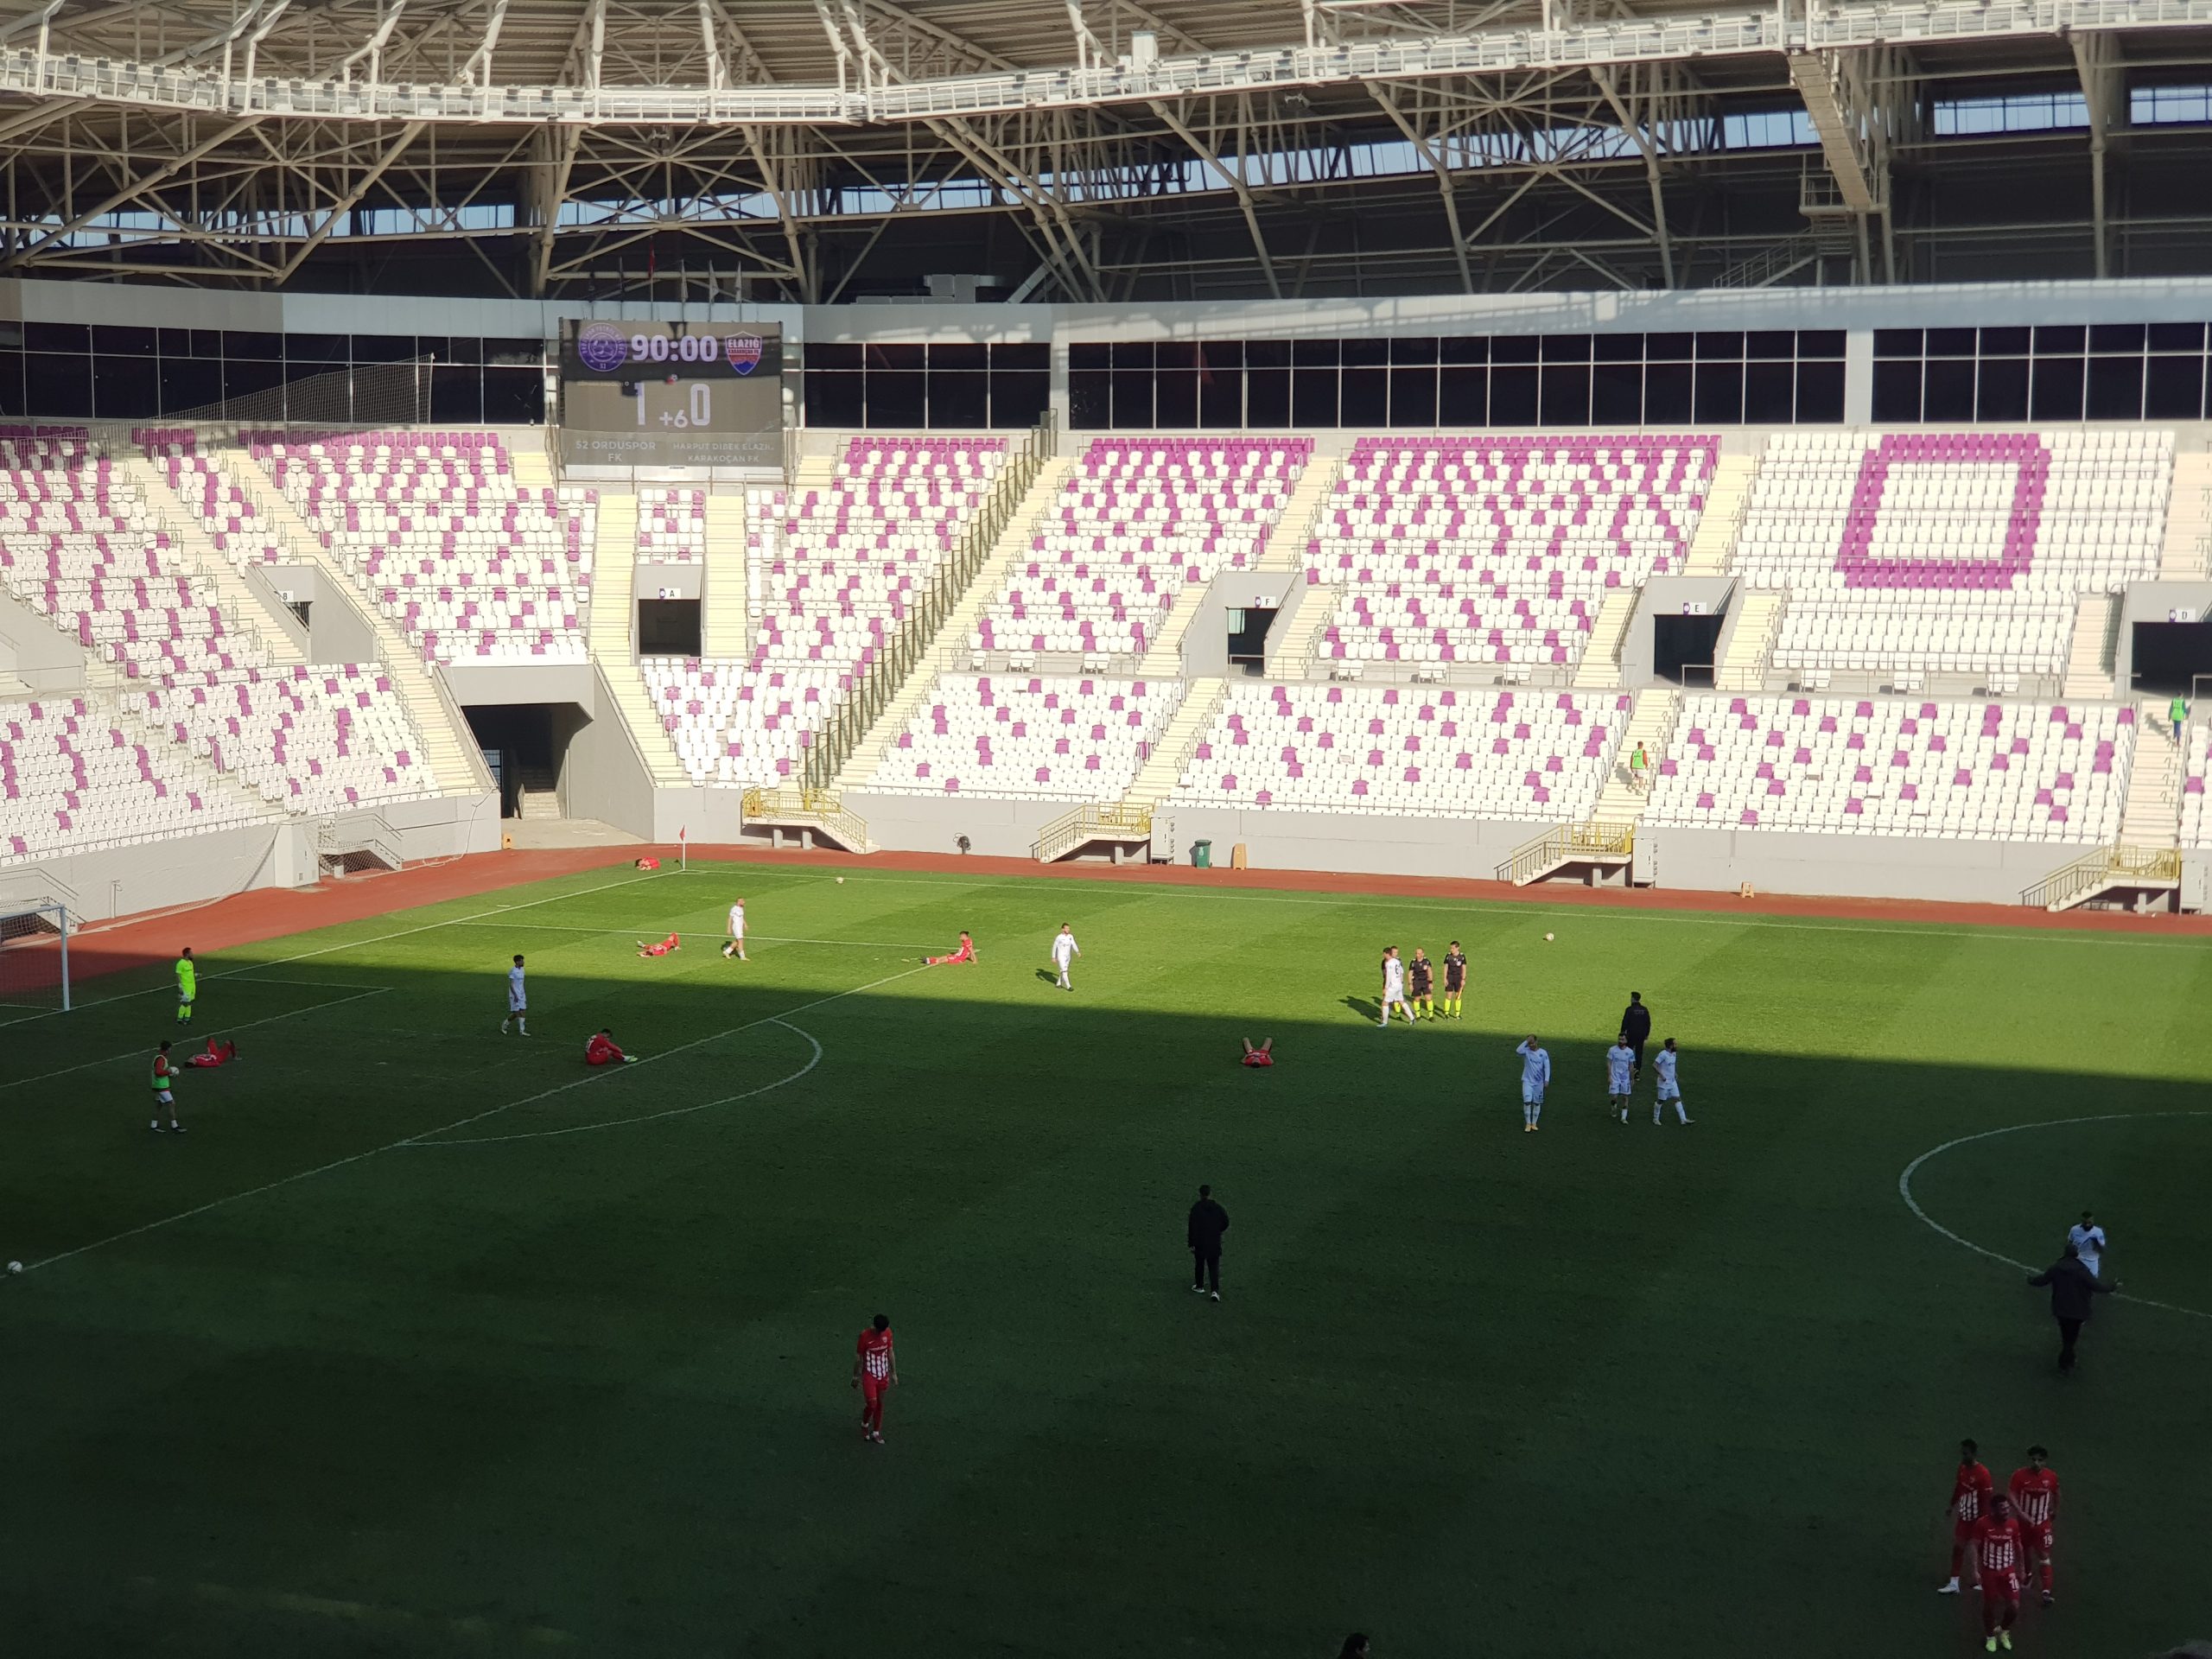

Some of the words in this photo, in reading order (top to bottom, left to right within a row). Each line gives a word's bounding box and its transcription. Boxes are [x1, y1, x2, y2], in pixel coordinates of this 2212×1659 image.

[728, 338, 760, 348] ELAZIĞ
[631, 334, 718, 362] 90:00
[634, 382, 645, 425] 1
[659, 410, 689, 428] +6
[690, 383, 710, 426] 0
[575, 441, 588, 449] 52
[592, 441, 656, 450] ORDUSPOR
[607, 454, 622, 462] FK
[688, 454, 746, 463] KARAKOÇAN
[669, 589, 675, 598] A
[1694, 604, 1700, 613] E
[2043, 1535, 2053, 1545] 19
